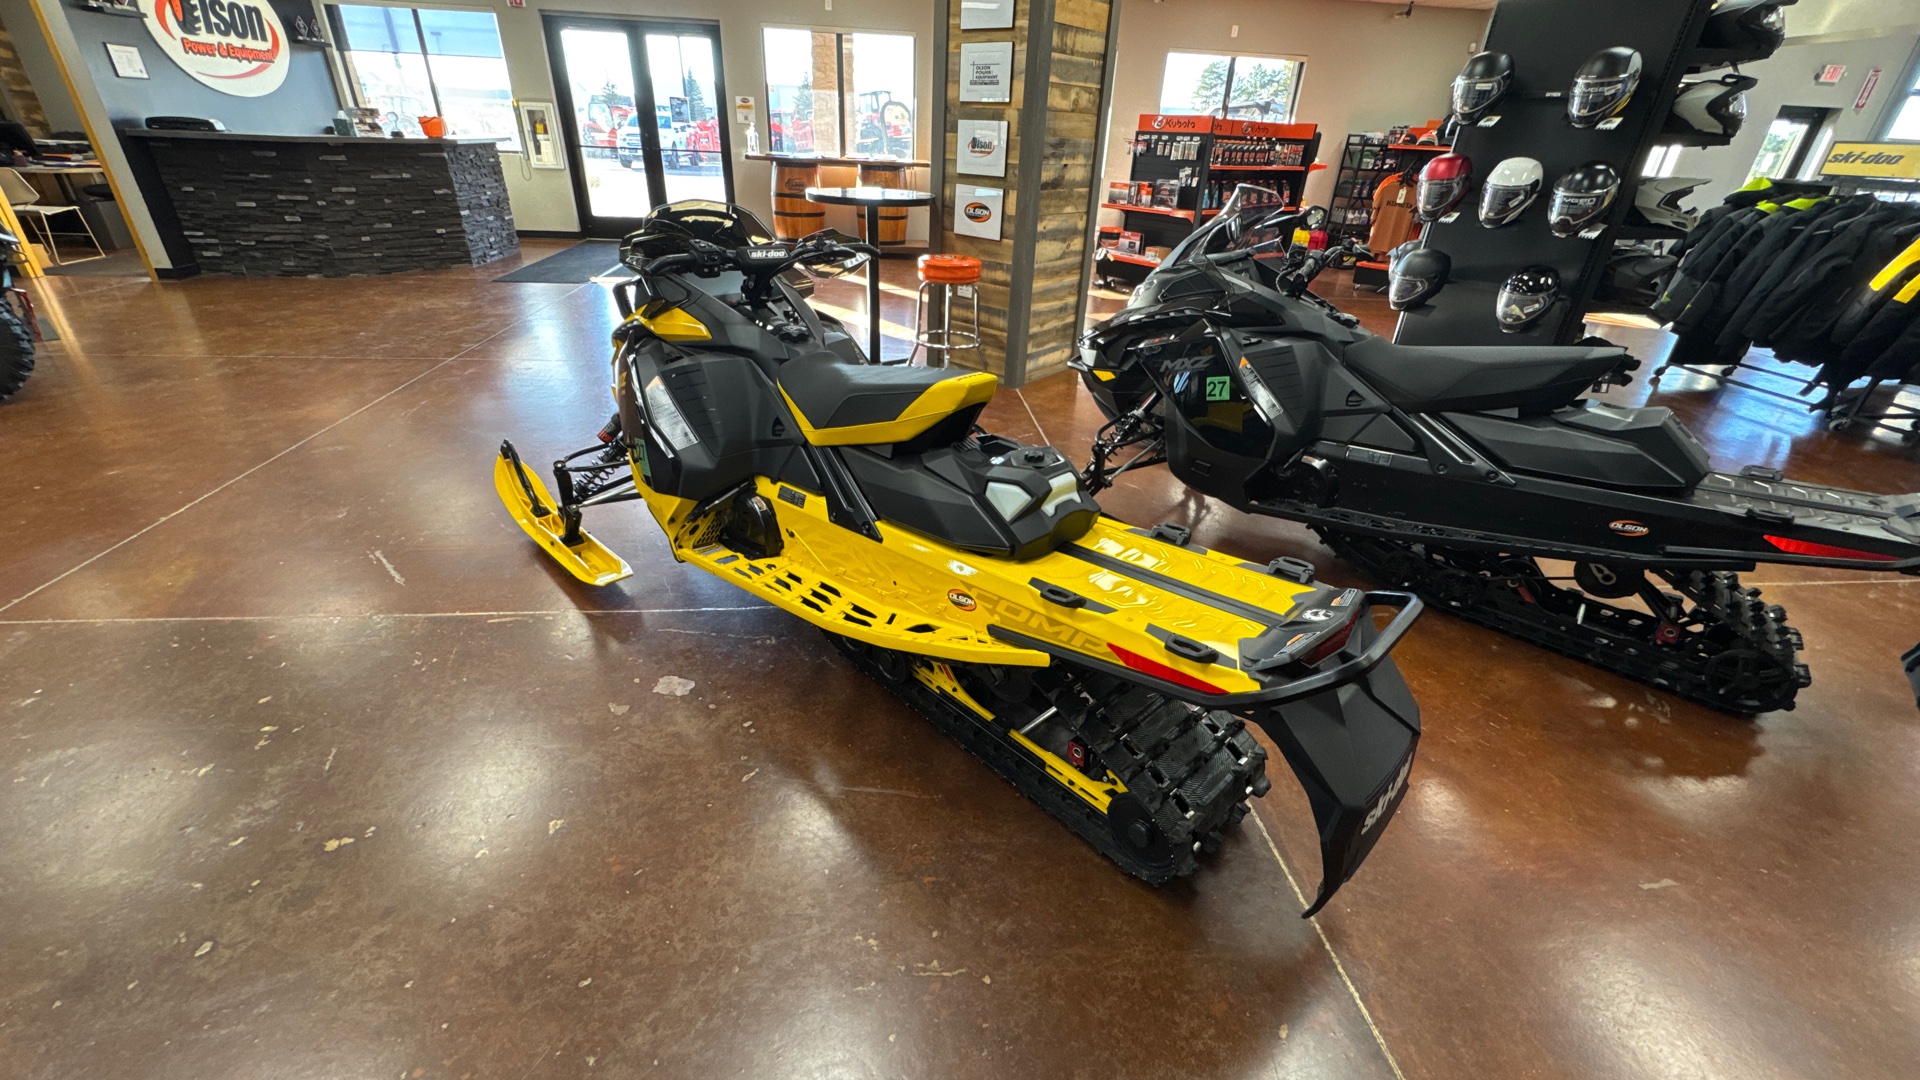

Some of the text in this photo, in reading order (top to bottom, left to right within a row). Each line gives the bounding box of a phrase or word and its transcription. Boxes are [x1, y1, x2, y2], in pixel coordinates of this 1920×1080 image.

[181, 37, 276, 63] Power & Equipment
[1165, 118, 1196, 129] Kubota
[1250, 124, 1269, 134] Kubota
[1826, 151, 1906, 165] ski-doo
[966, 207, 990, 216] OLSON
[751, 250, 785, 258] ski-doo
[1160, 355, 1216, 373] MXZ
[1207, 381, 1227, 398] 27
[1611, 522, 1649, 533] OLSON
[949, 592, 975, 605] OLSON
